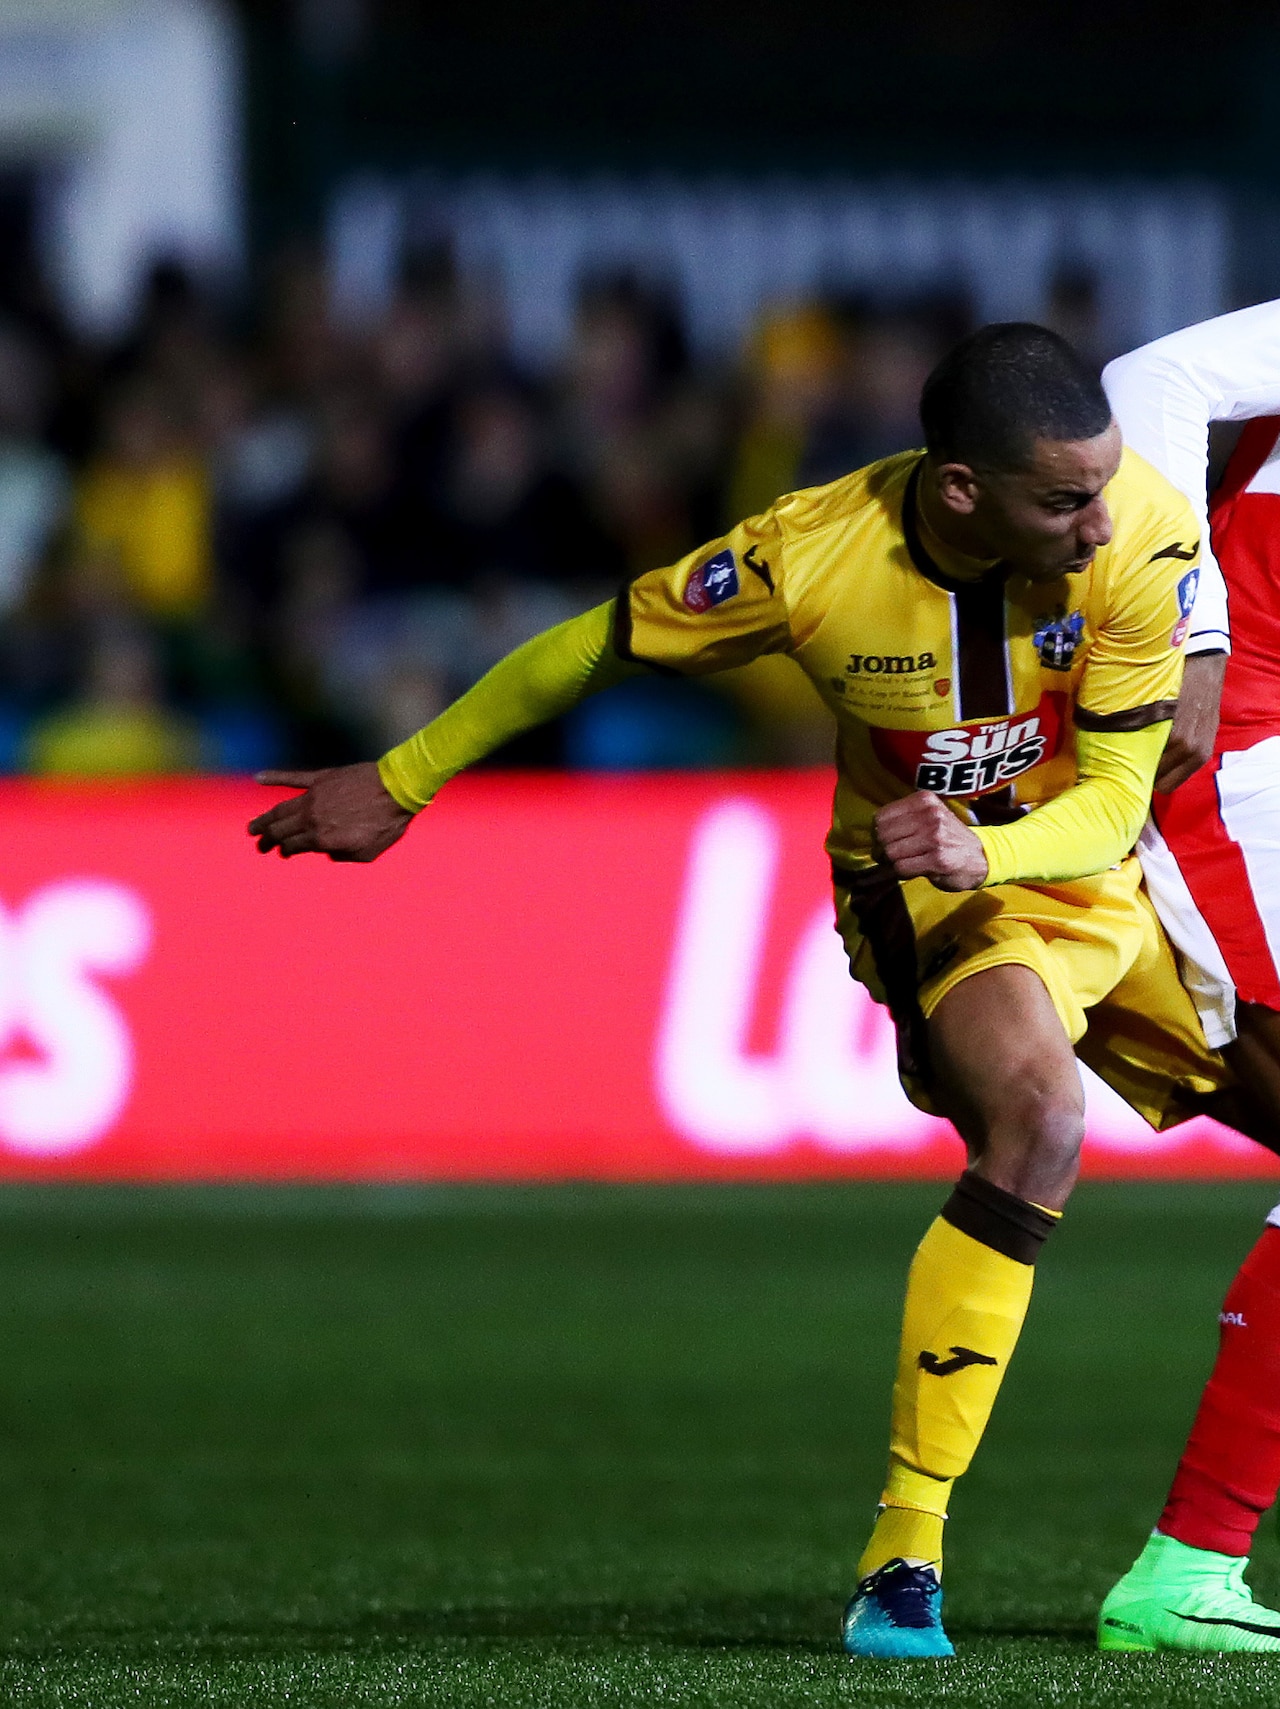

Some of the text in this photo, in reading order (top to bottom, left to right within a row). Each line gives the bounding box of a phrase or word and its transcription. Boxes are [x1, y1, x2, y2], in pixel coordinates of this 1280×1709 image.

[847, 653, 936, 673] Joma
[921, 717, 1040, 763] Sun
[980, 721, 1010, 735] THE
[916, 735, 1047, 795] BETS
